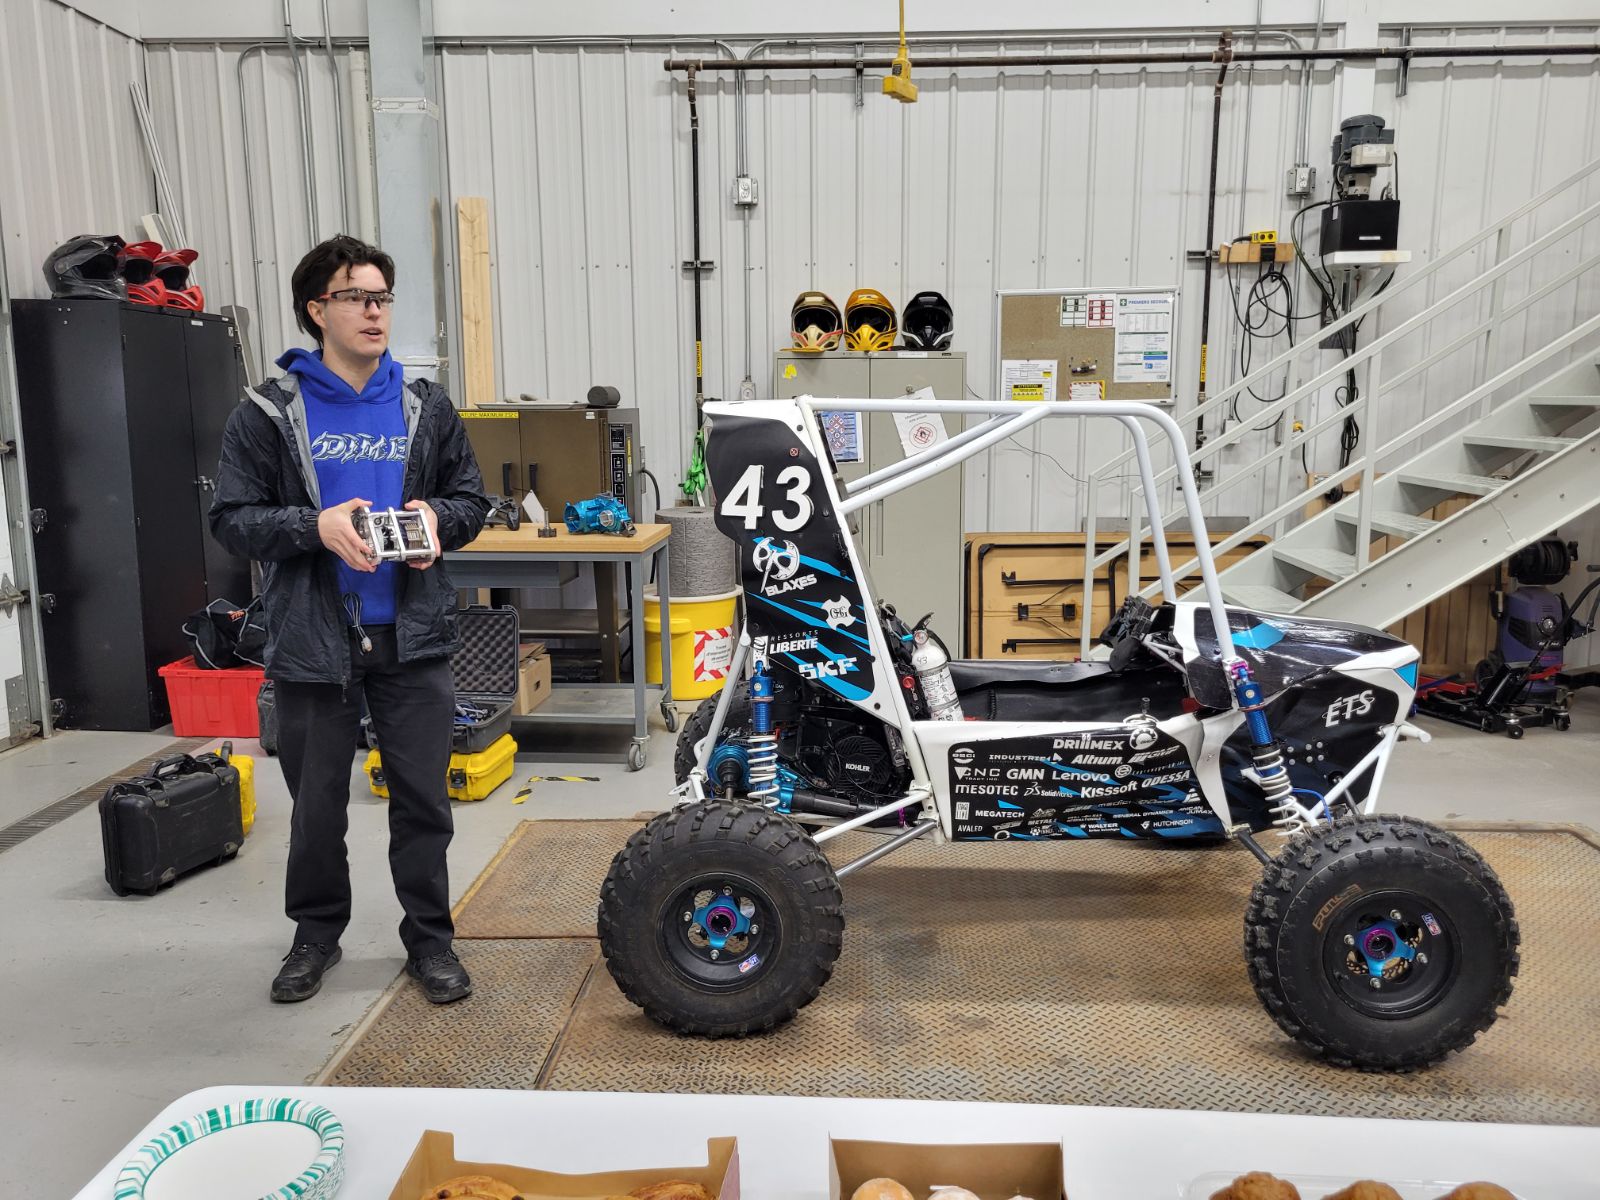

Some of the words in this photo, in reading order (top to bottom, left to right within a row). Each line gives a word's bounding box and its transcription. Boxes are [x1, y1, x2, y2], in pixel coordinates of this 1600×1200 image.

[720, 465, 814, 532] 43
[765, 573, 818, 597] BLAXES
[770, 629, 819, 641] RESSORTS
[916, 656, 928, 665] 43
[798, 657, 858, 680] SKF
[1324, 690, 1374, 728] ÉTS
[845, 763, 871, 772] KOHLER
[1006, 768, 1045, 780] GMN
[1052, 770, 1110, 782] Lenovo
[1141, 769, 1191, 788] ODESSA
[975, 810, 1025, 818] MEGATECH
[1153, 819, 1194, 828] HUTCHINSON
